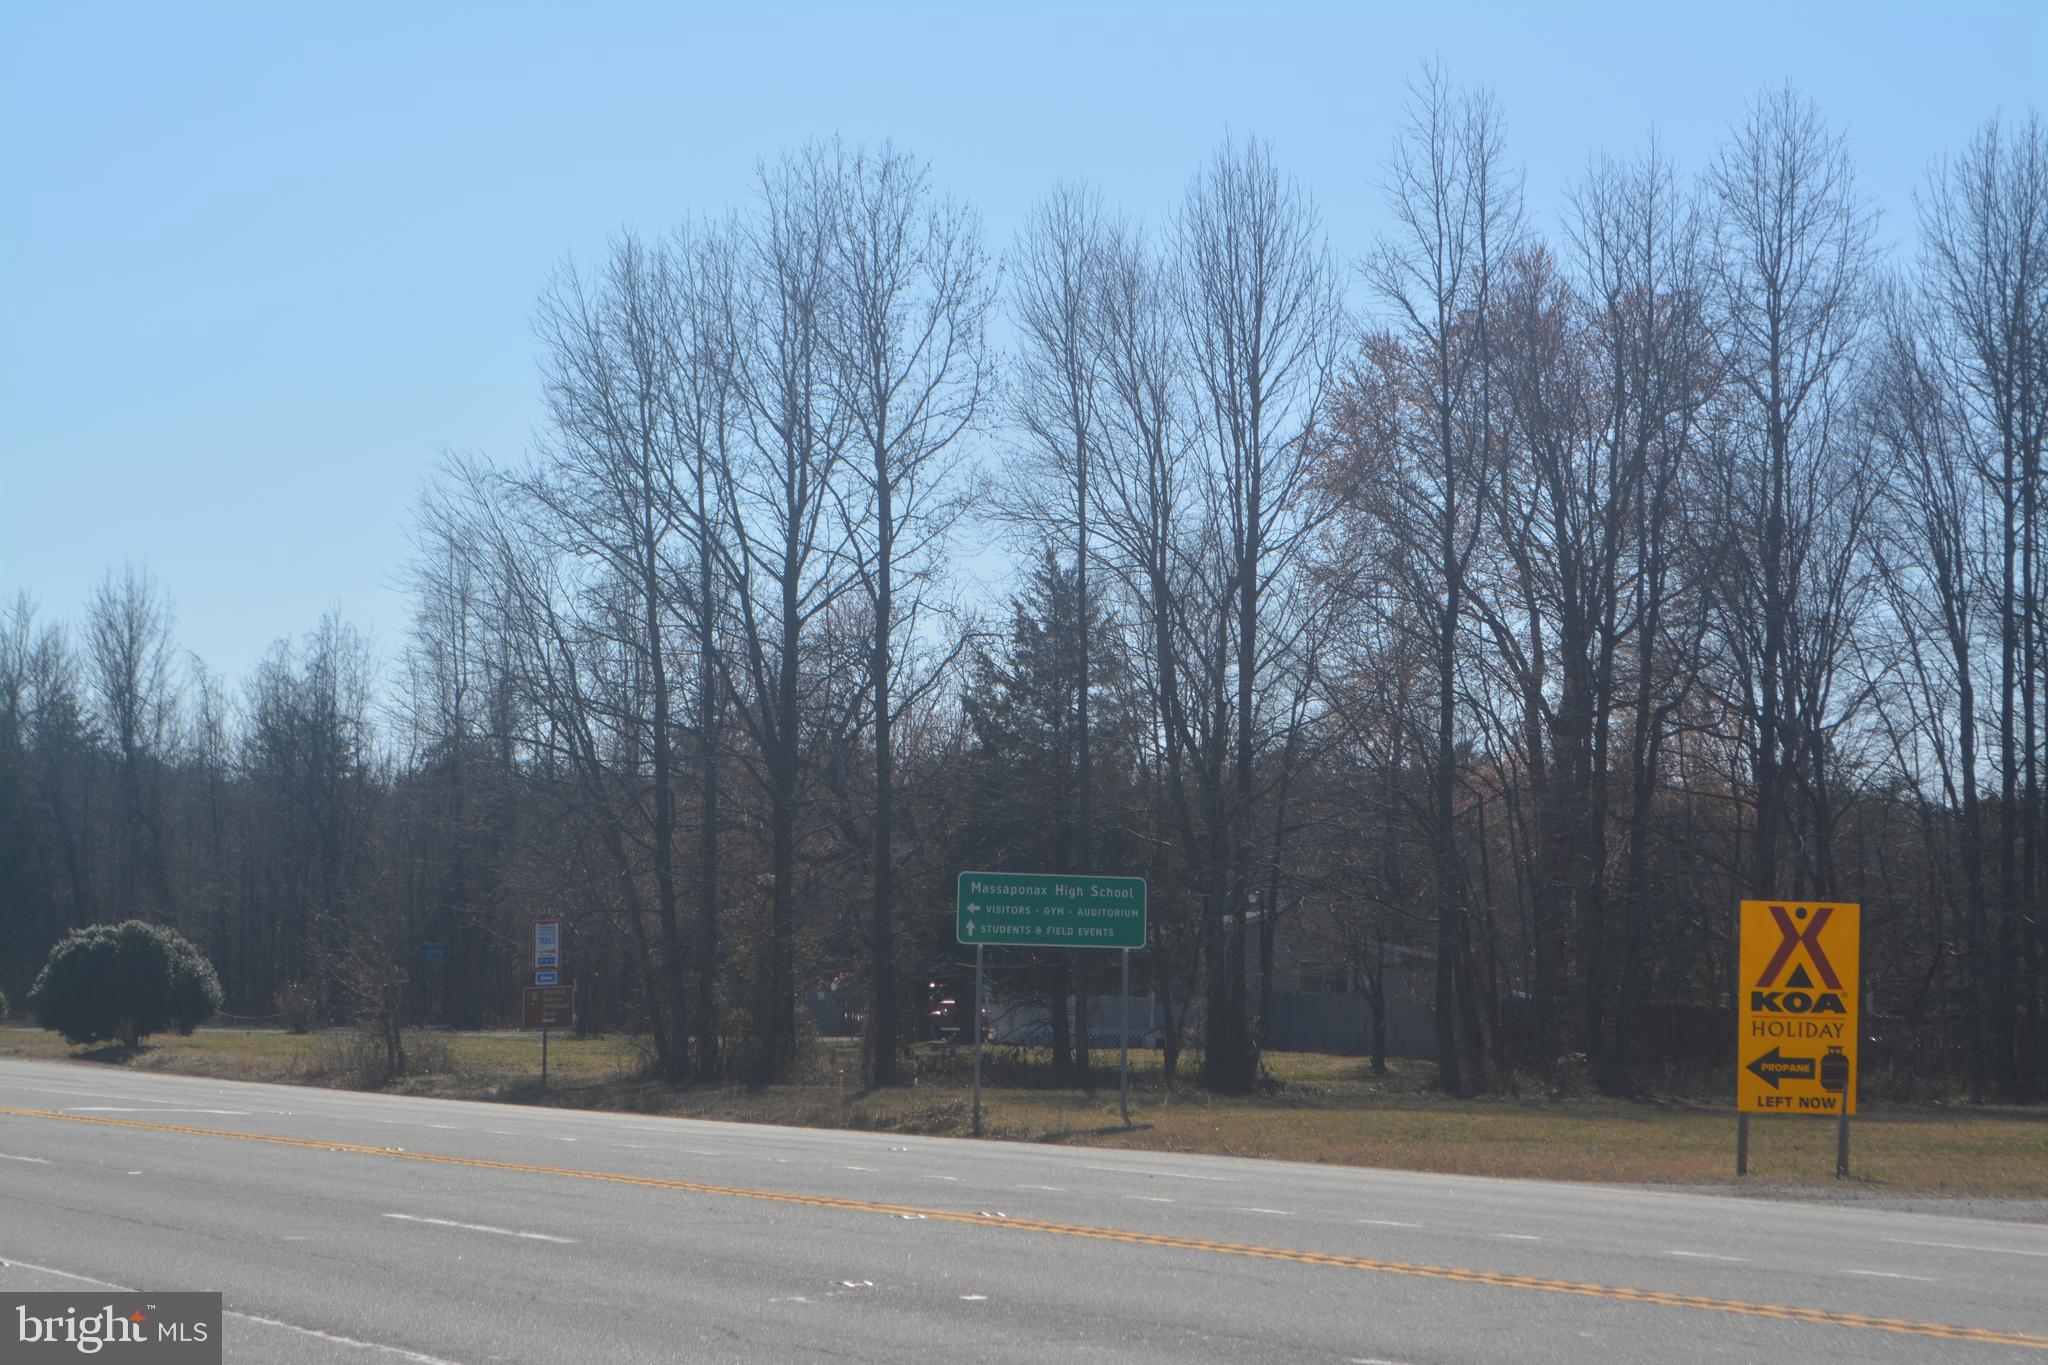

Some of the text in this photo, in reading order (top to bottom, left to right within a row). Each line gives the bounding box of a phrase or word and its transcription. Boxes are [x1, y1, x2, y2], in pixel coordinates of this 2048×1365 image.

[971, 881, 1134, 899] Massaponax High School
[986, 904, 1031, 915] VISITORS
[1043, 906, 1065, 916] GYM
[1077, 908, 1139, 918] AUDITORIUM
[980, 924, 1031, 935] STUDENTS
[1046, 926, 1074, 936] FIELD
[1078, 927, 1114, 937] EVENTS
[1751, 991, 1847, 1014] KOA
[1752, 1021, 1845, 1039] HOLIDAY
[1761, 1063, 1810, 1073] PROPANE
[1757, 1096, 1837, 1109] LEFT NOW
